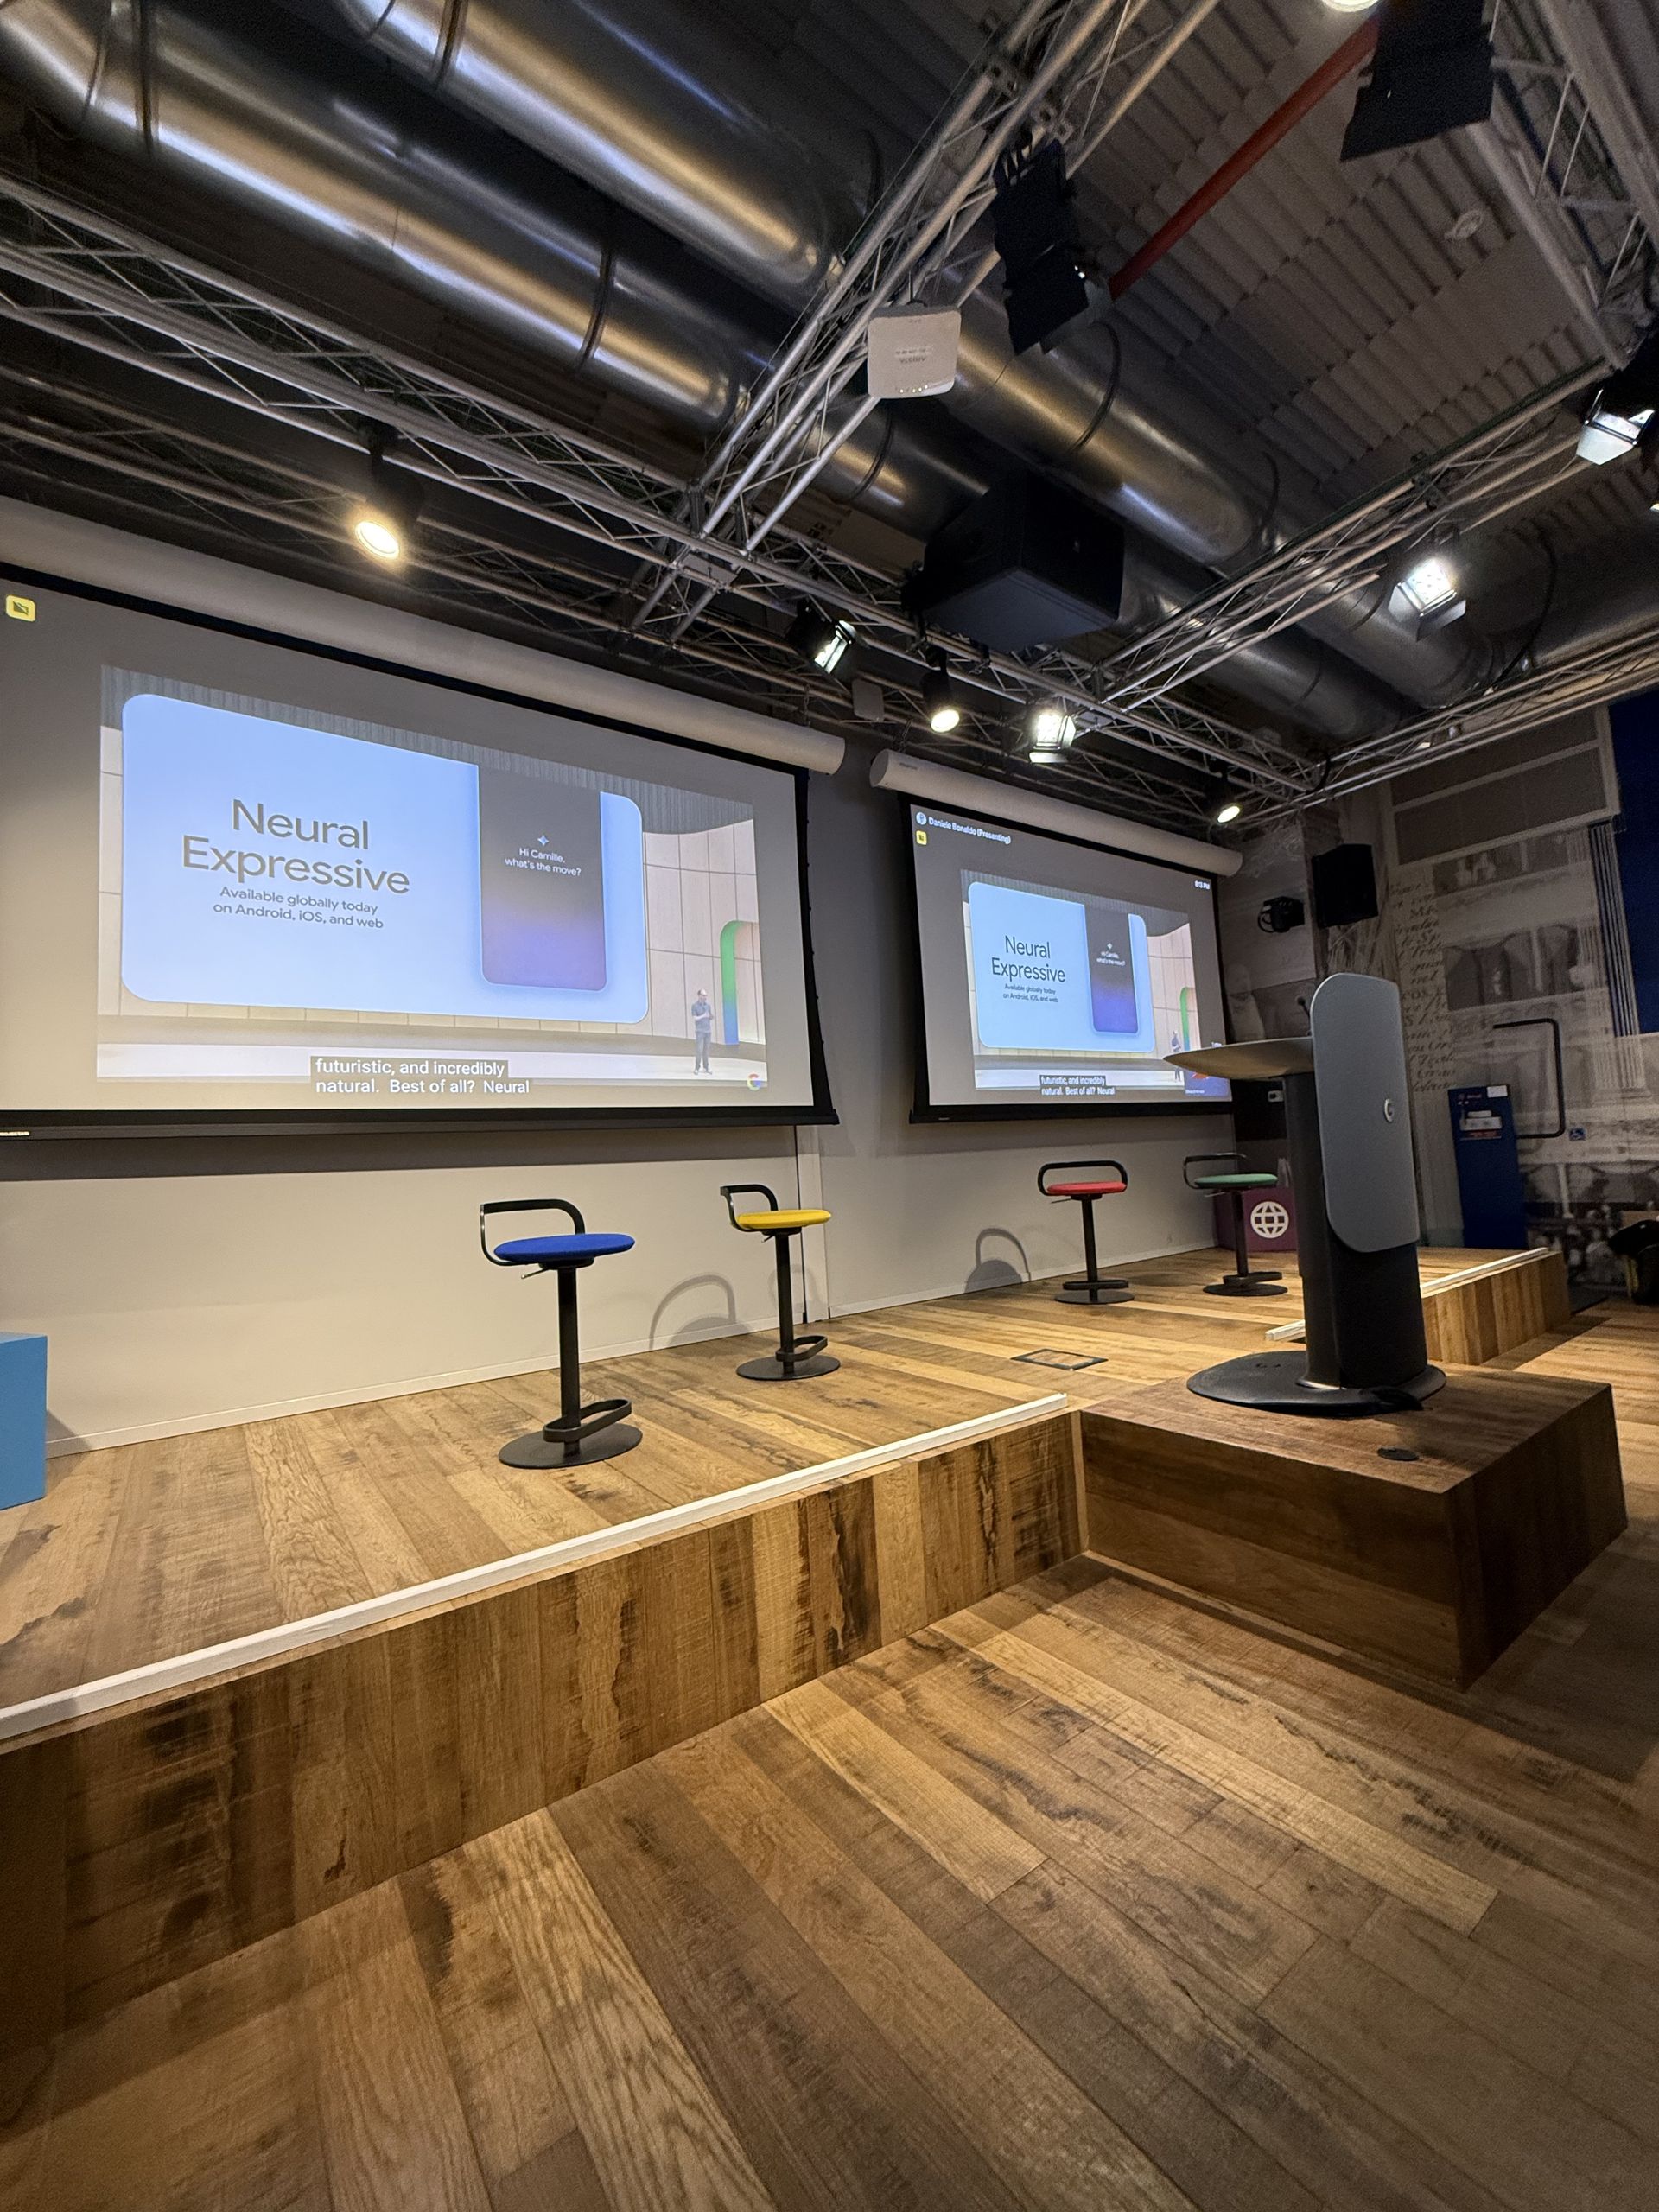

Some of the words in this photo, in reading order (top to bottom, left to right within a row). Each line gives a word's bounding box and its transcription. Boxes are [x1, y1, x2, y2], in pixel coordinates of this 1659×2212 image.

[232, 798, 369, 850] Neural
[976, 828, 1012, 845] (Presenting)
[183, 835, 410, 894] Expressive
[518, 848, 529, 857] Hi
[505, 858, 535, 870] what's
[536, 862, 551, 872] the
[552, 865, 582, 876] move?
[219, 886, 284, 903] Available
[287, 893, 339, 911] globally
[341, 900, 378, 916] today
[213, 904, 232, 914] on
[235, 904, 296, 921] Android,
[299, 910, 327, 924] iOS,
[329, 916, 353, 925] and
[356, 918, 384, 929] web
[1005, 935, 1051, 959] Neural
[991, 957, 1065, 982] Expressive
[315, 1058, 395, 1076] futuristic,
[399, 1060, 429, 1074] and
[434, 1061, 505, 1077] incredibly
[315, 1078, 379, 1093] natural.
[390, 1079, 425, 1093] Best
[429, 1079, 445, 1093] of
[449, 1079, 475, 1093] all?
[483, 1080, 530, 1093] Neural
